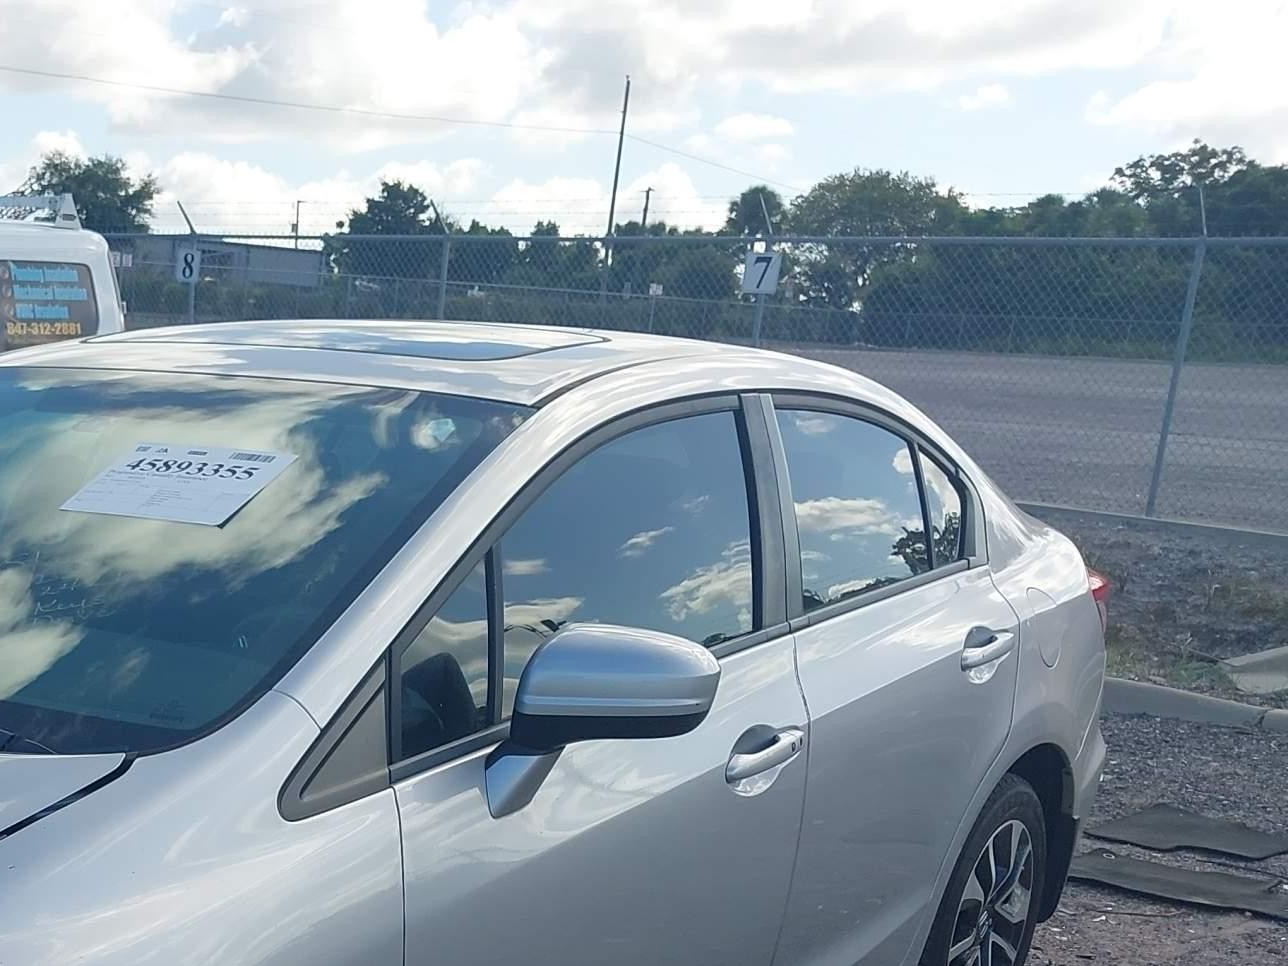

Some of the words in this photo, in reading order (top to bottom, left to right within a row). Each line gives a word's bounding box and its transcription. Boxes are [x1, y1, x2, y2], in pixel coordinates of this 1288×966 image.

[182, 252, 195, 279] 8
[754, 256, 773, 289] 7
[125, 457, 261, 481] 45893355
